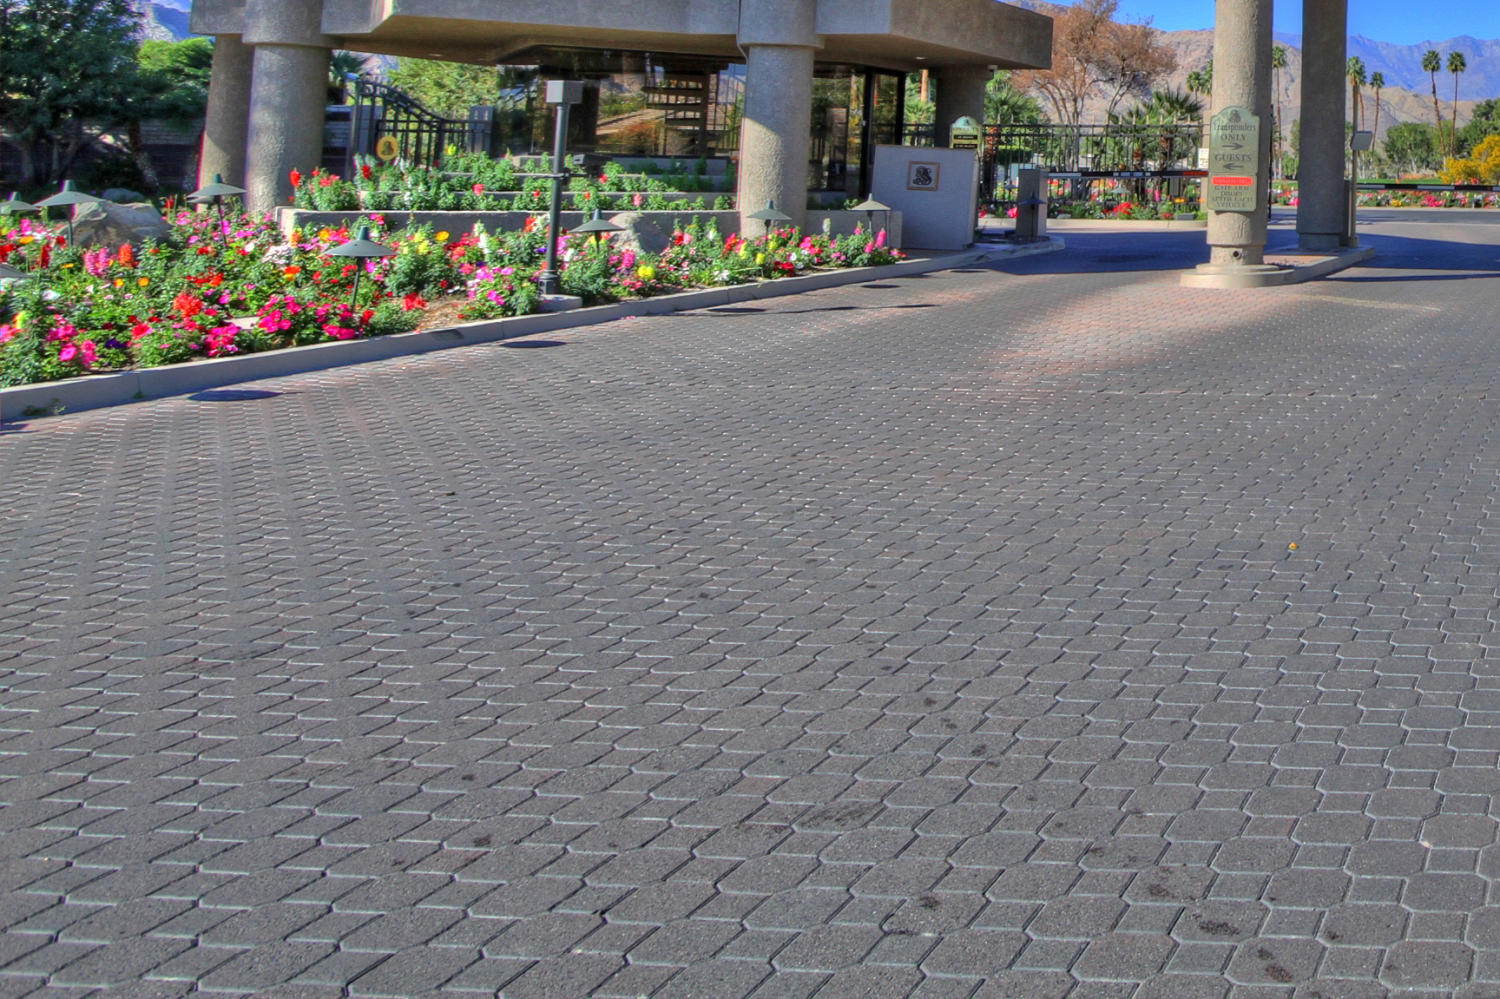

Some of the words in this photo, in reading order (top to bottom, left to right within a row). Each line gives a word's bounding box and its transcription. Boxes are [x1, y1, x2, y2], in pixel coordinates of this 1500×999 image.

[1213, 121, 1256, 133] Transponders
[1220, 133, 1248, 141] ONLY
[1214, 153, 1252, 162] GUESTS
